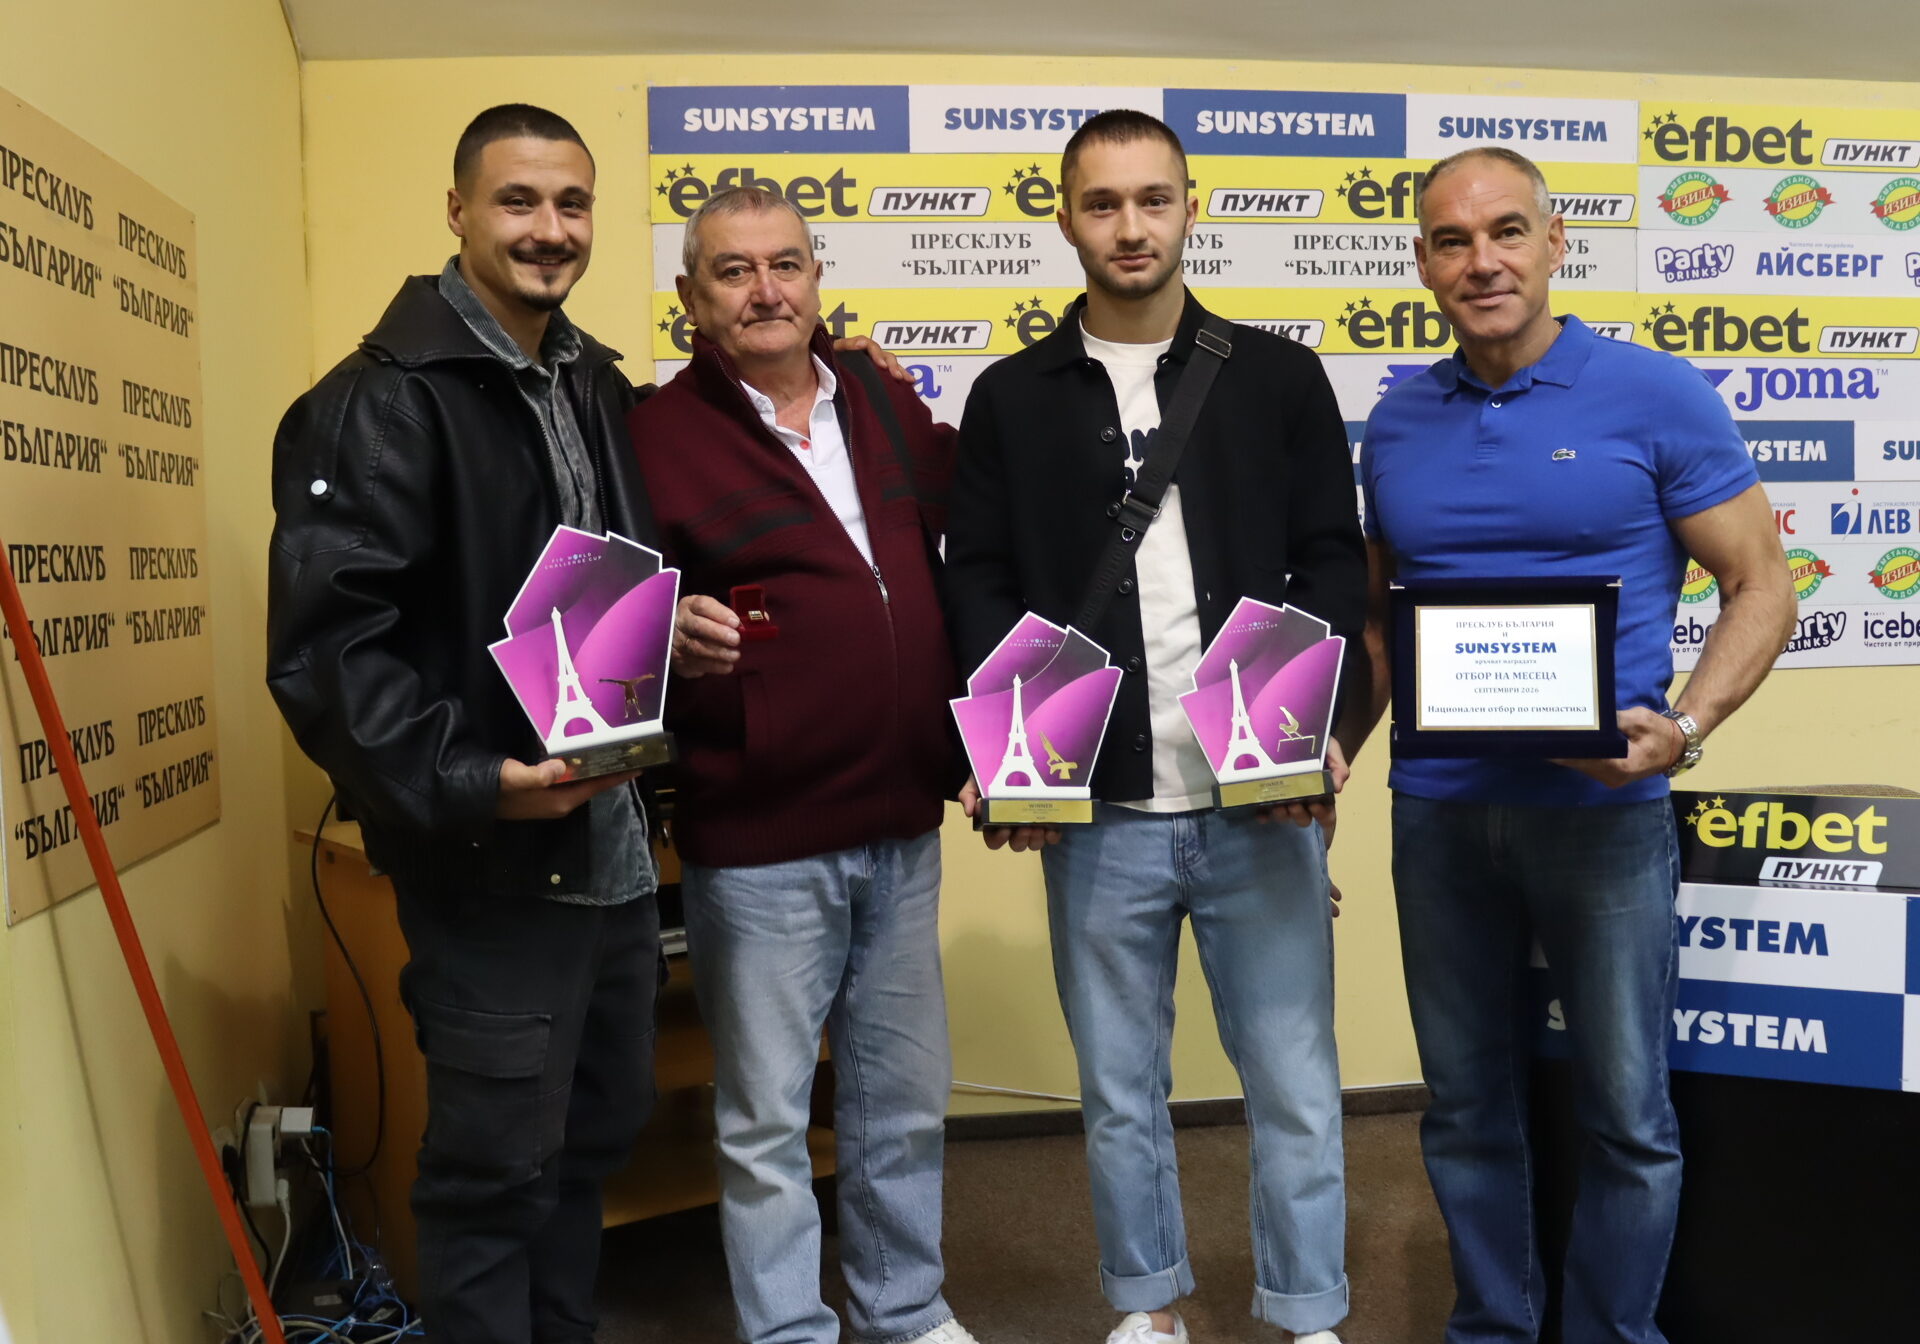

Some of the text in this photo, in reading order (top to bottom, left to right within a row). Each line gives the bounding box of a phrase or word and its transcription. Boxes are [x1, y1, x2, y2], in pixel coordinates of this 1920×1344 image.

[684, 107, 875, 131] SUNSYSTEM
[944, 108, 1112, 131] SUNSYST
[1196, 110, 1375, 136] SUNSYSTEM
[1438, 116, 1607, 142] SUNSYSTEM
[1654, 116, 1813, 165] efbet
[1833, 144, 1911, 162] ПУНКТ
[882, 192, 976, 211] ПУНКТ
[1671, 186, 1715, 210] ИЗИДА
[1776, 189, 1818, 212] ИЗИДА
[1879, 179, 1920, 201] СМЕТАНО
[1220, 194, 1310, 213] ПУНКТ
[118, 212, 187, 280] ПРЕСКЛУБ
[911, 233, 1032, 250] ПРЕСКЛУБ
[1293, 234, 1408, 251] ПРЕСКЛУБ
[1655, 244, 1734, 273] Party
[1756, 247, 1883, 277] АЙСБЕРГ
[1666, 267, 1718, 281] DRINKS
[884, 326, 977, 345] ПУНКТ
[1348, 302, 1462, 348] efb
[1653, 306, 1810, 352] efbet
[1830, 332, 1907, 348] ПУНКТ
[0, 342, 98, 405] ПРЕСКЛУБ
[122, 379, 192, 429] ПРЕСКЛУБ
[1744, 440, 1827, 461] YSTEM
[1868, 509, 1911, 534] ЛЕВ
[8, 544, 106, 583] ПРЕСКЛУБ
[129, 546, 199, 581] ПРЕСКЛУБ
[1786, 550, 1815, 561] ТАНОВ
[1792, 562, 1818, 580] ИДА
[1505, 620, 1555, 628] БЪЛГАРИЯ
[1793, 612, 1846, 640] rty
[1455, 642, 1557, 654] SUNSYSTEM
[1783, 636, 1831, 652] RINKS
[1455, 671, 1557, 681] ОТБОР НА МЕСЕЦА
[138, 696, 206, 746] ПРЕСКЛУБ
[1428, 705, 1485, 714] Национален
[1488, 704, 1515, 715] отбор
[1531, 705, 1588, 713] гимнастика
[1697, 801, 1887, 855] efbet
[1773, 861, 1868, 882] ПУНКТ
[1677, 915, 1829, 957] YSTEM
